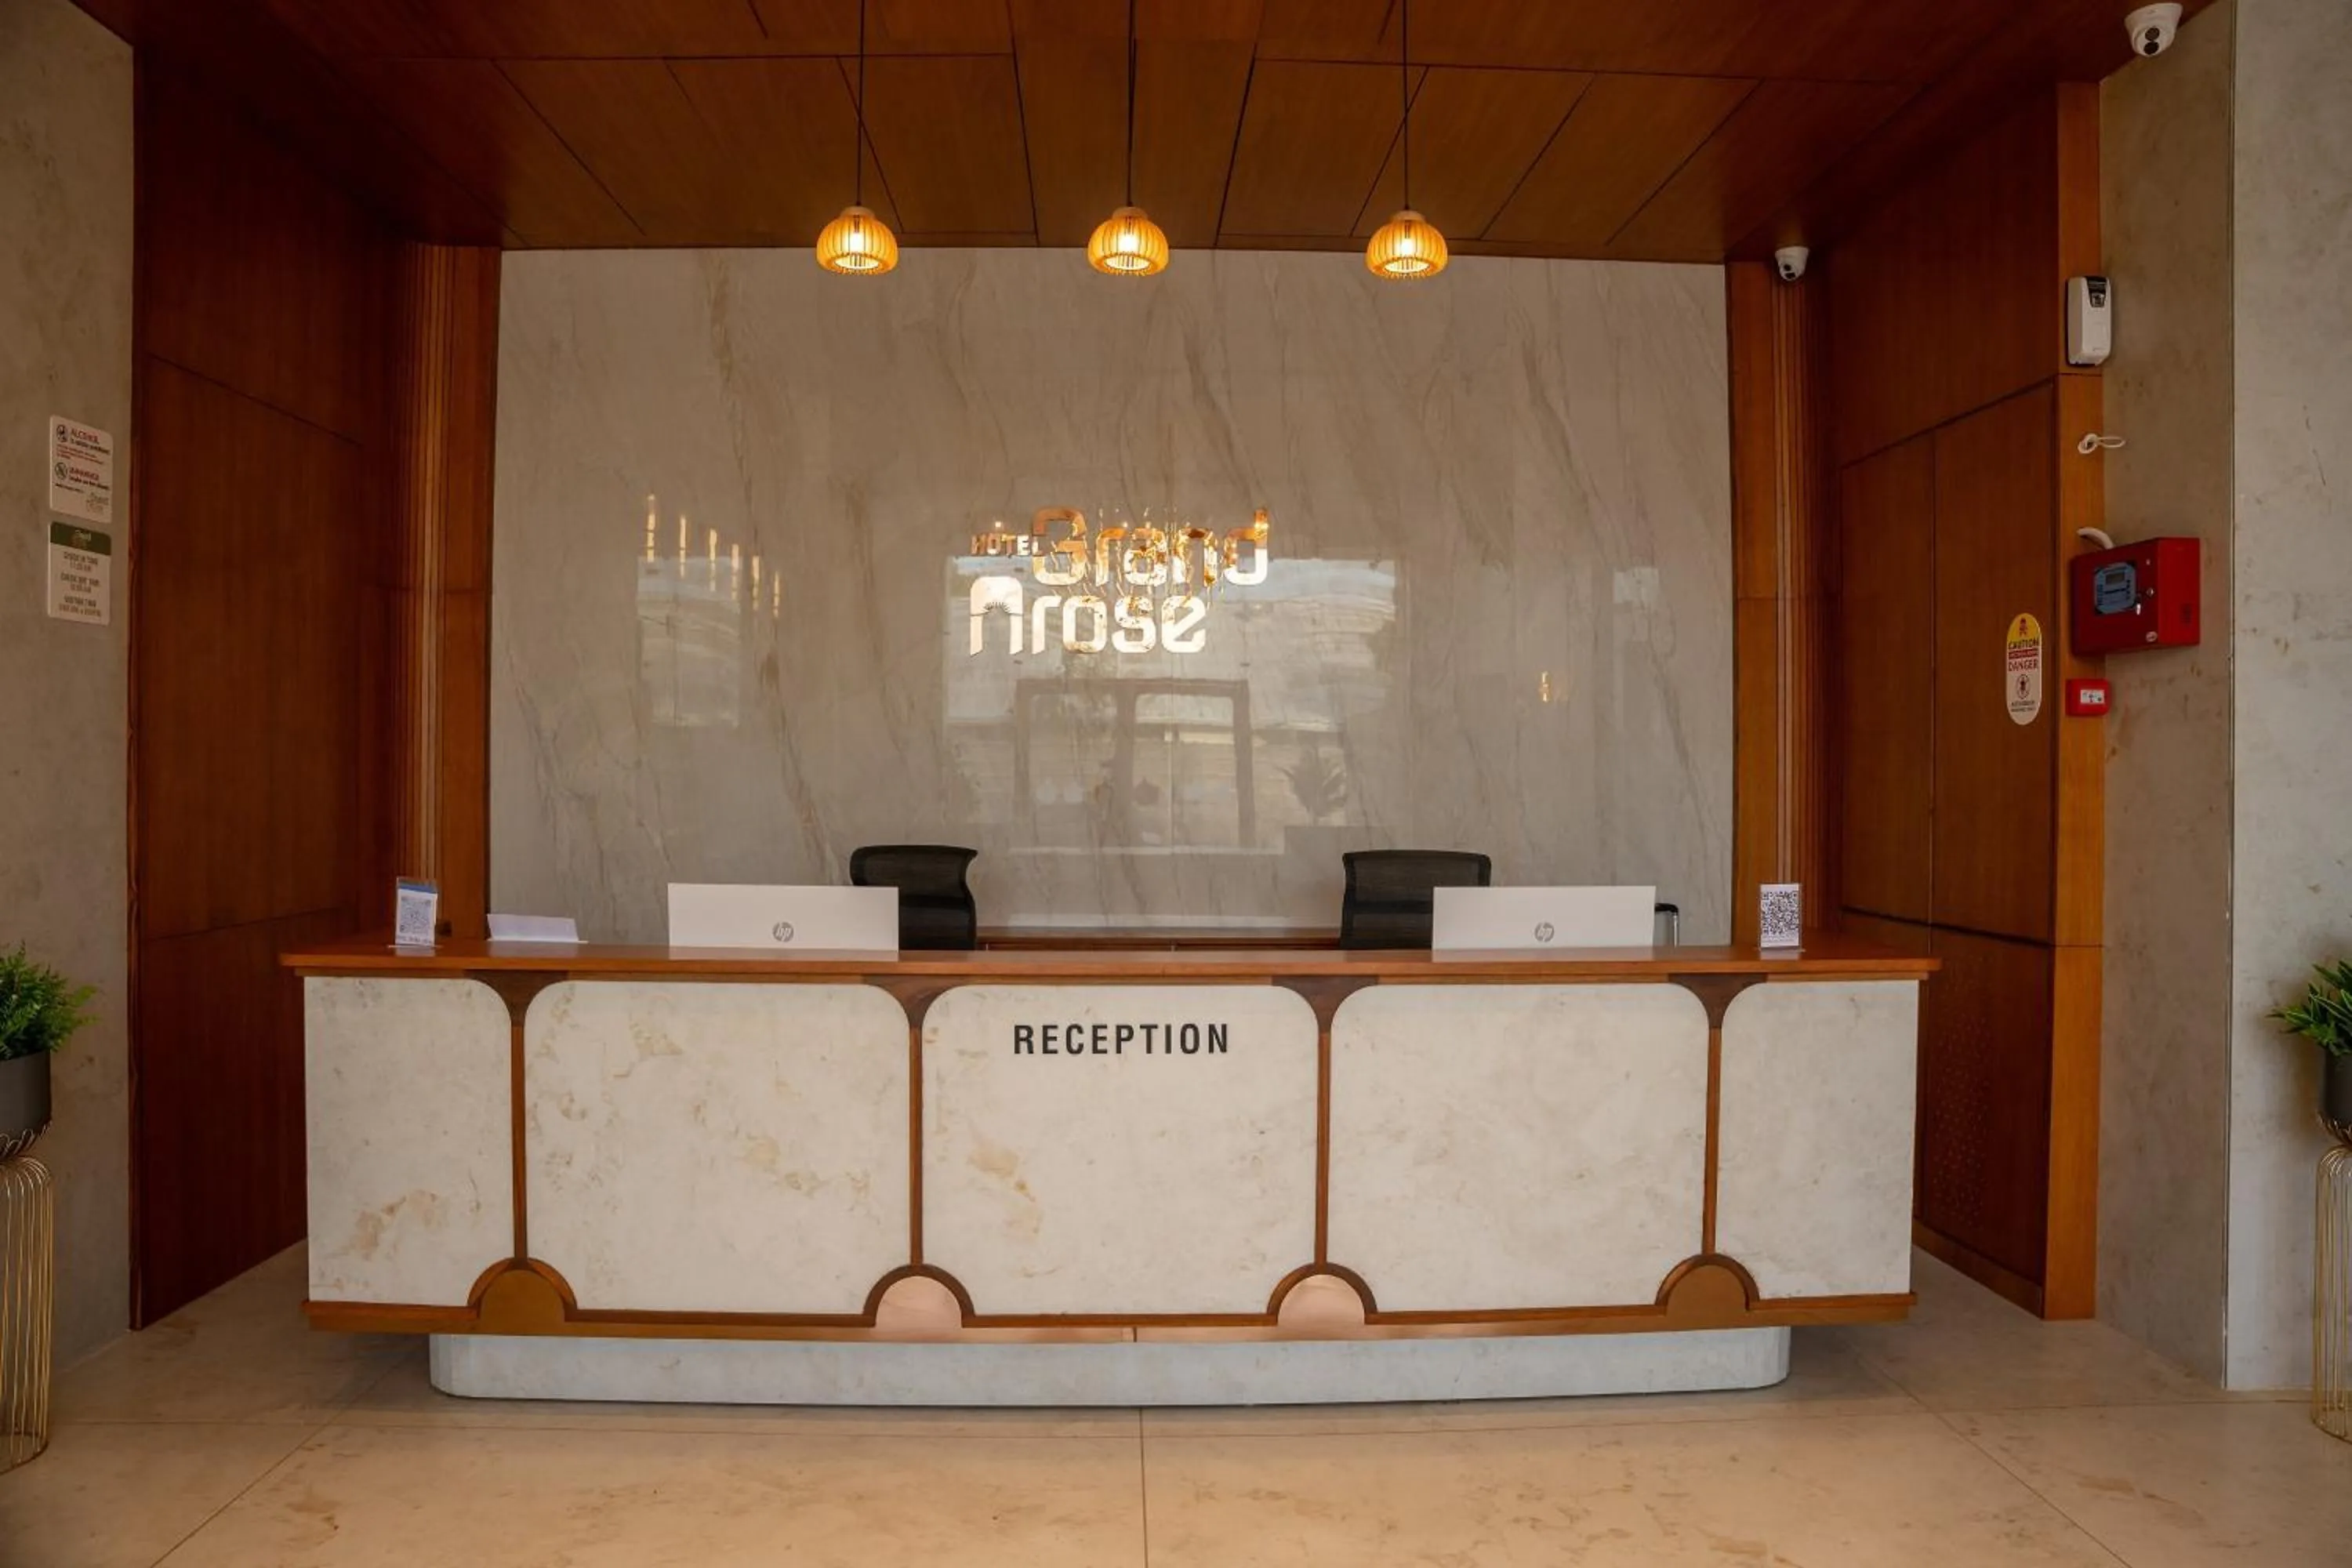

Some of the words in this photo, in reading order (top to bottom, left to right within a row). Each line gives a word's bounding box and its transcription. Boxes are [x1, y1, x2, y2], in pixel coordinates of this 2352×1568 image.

[971, 533, 1044, 556] HOTEL
[2008, 637, 2038, 650] CAUTION
[2008, 659, 2038, 672] DANGER
[1014, 1023, 1228, 1054] RECEPTION
